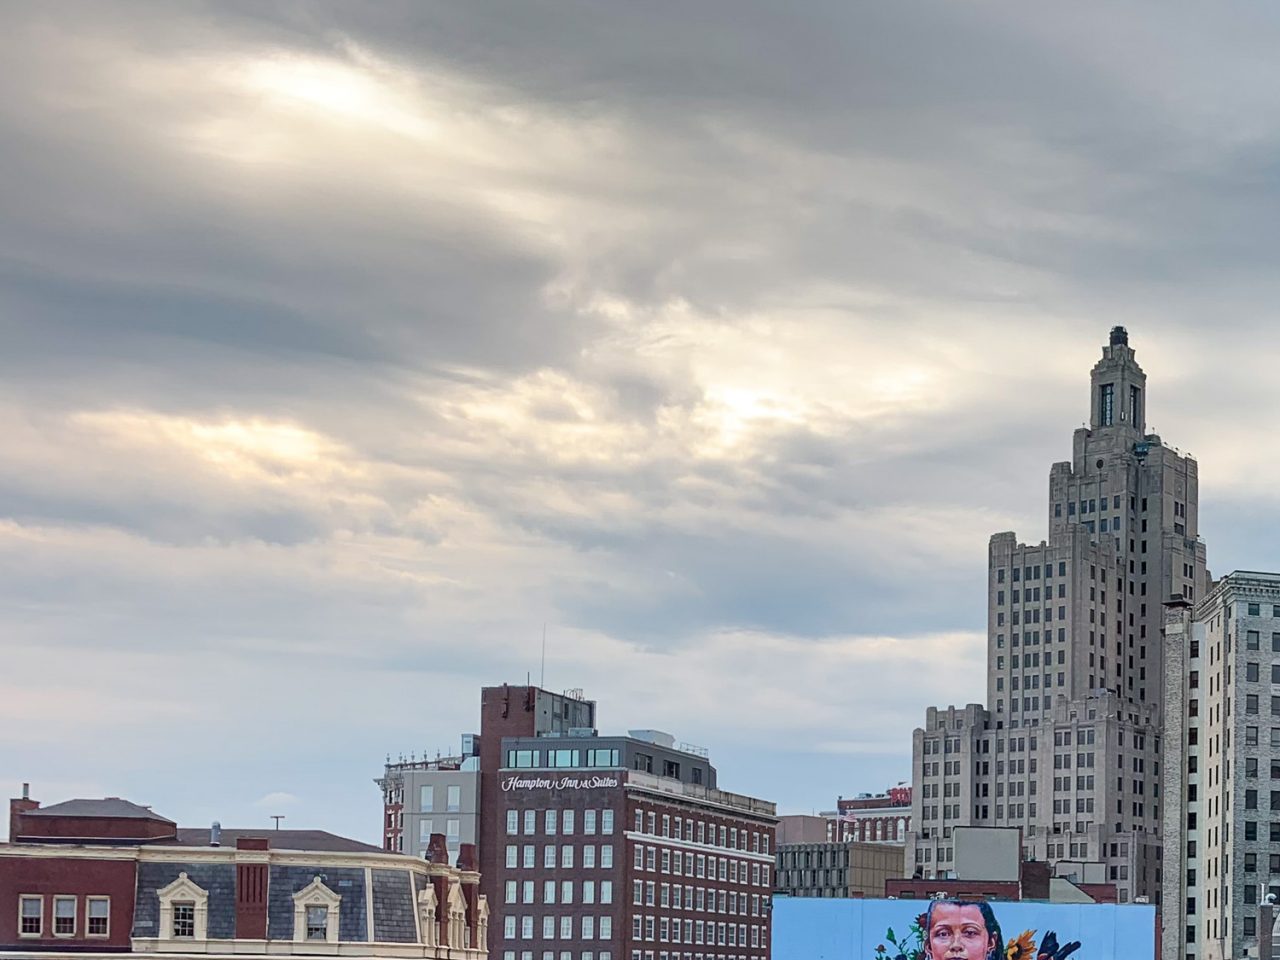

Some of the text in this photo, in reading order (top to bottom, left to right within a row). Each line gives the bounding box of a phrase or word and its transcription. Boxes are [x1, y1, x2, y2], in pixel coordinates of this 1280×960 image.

[502, 776, 554, 791] Hampton
[555, 776, 583, 790] Inn
[588, 776, 618, 789] Suites
